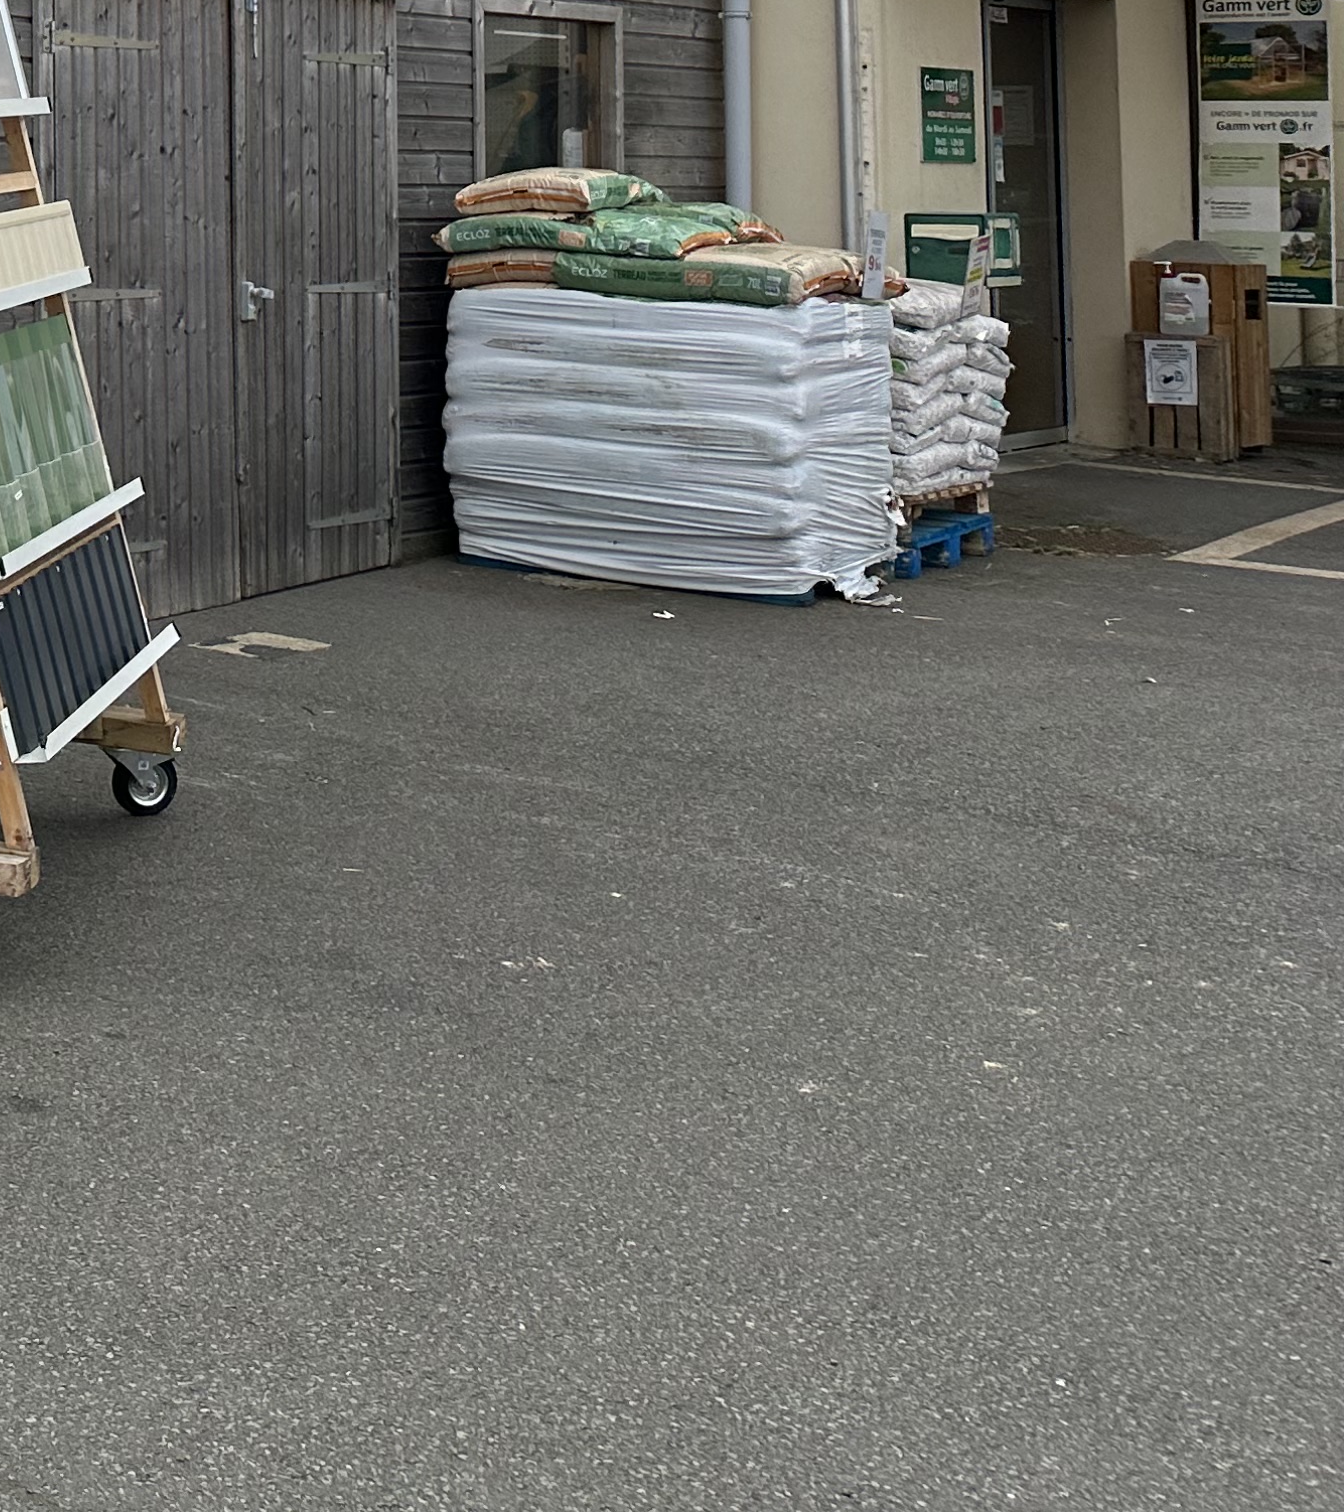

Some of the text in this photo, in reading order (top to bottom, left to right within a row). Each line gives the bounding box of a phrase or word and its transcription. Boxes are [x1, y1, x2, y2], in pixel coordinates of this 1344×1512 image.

[1202, 0, 1252, 13] Gamm
[924, 74, 945, 92] Gamm
[1217, 121, 1314, 131] Gamm vert .fr
